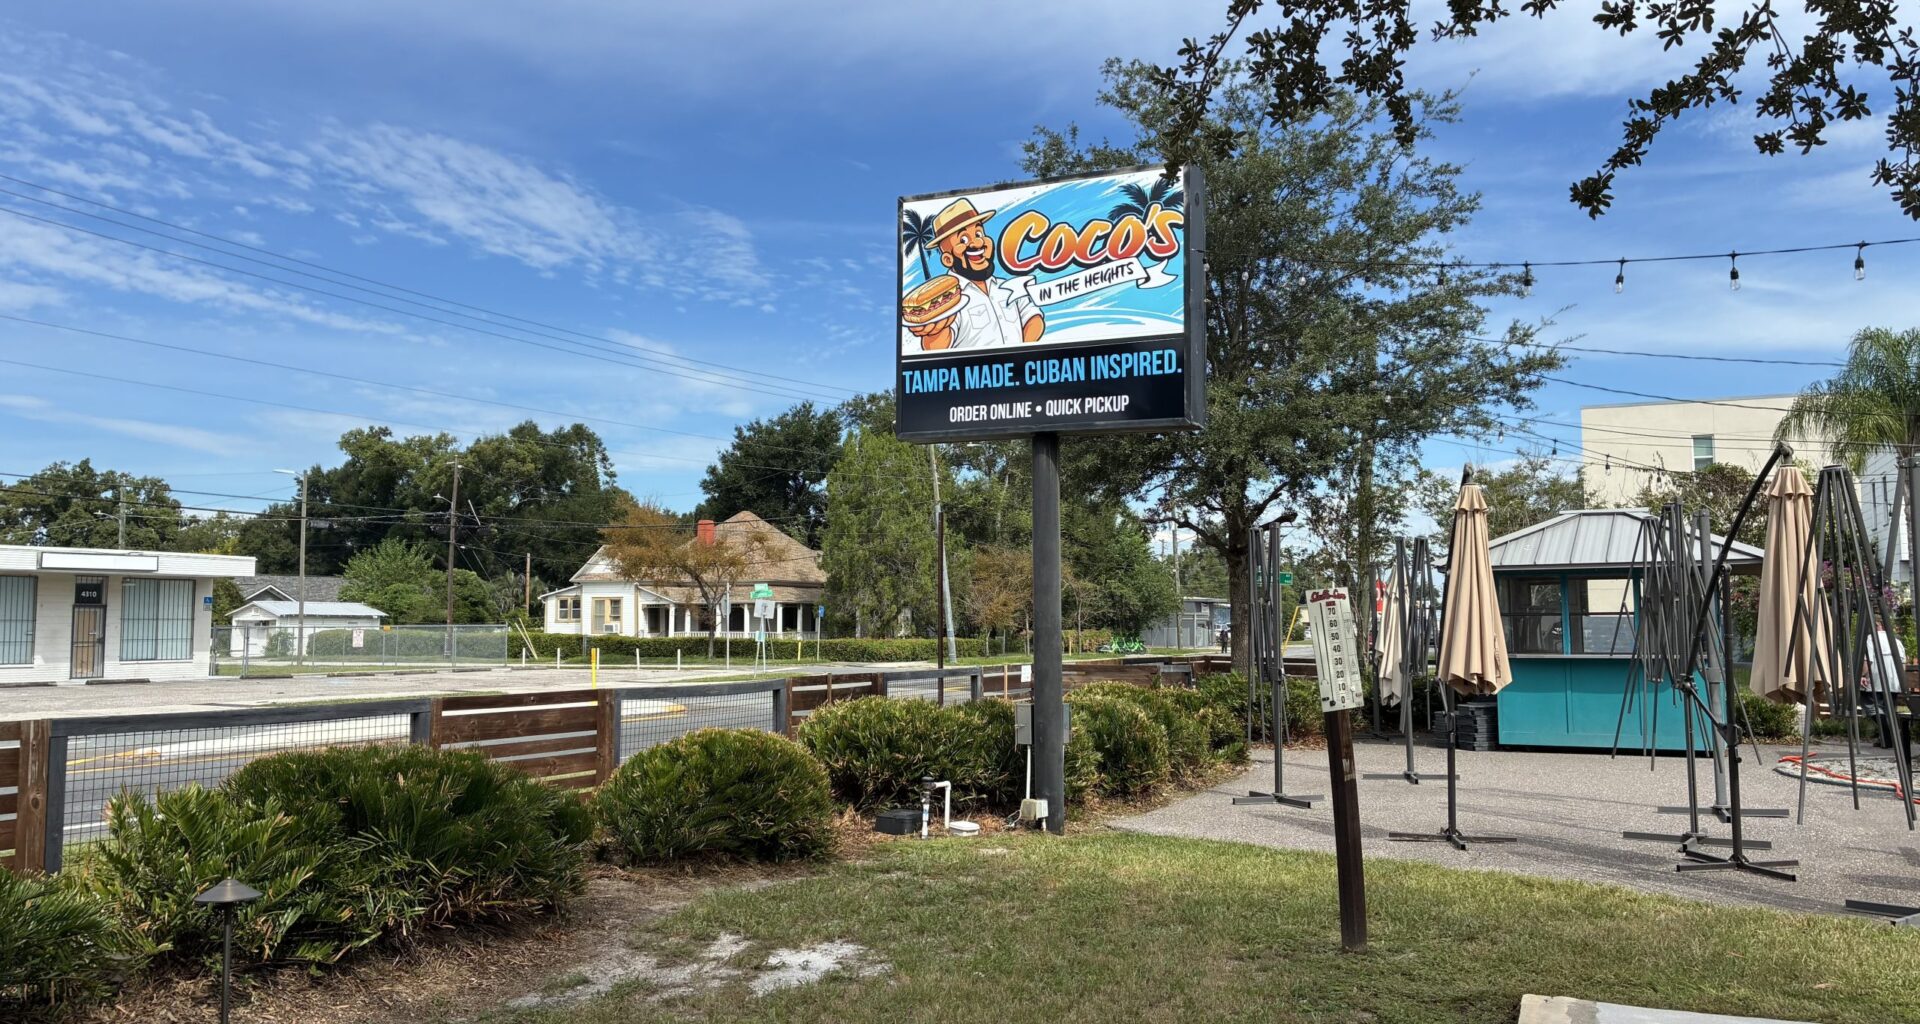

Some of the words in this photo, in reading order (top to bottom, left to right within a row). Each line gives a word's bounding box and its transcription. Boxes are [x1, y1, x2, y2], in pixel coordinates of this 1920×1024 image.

[1039, 287, 1052, 301] IN
[1056, 278, 1080, 295] THE
[1084, 262, 1134, 287] HEIGHTS
[902, 367, 960, 394] TAMPA
[965, 362, 1020, 390] MADE.
[1025, 355, 1085, 385] CUBAN
[1091, 349, 1182, 380] INSPIRED.
[949, 405, 987, 423] ORDER
[990, 401, 1032, 420] ONLINE
[1045, 398, 1081, 417] QUICK
[1084, 394, 1130, 414] PICKUP
[1328, 607, 1336, 615] 70
[1330, 620, 1338, 628] 60
[1338, 683, 1346, 691] 10
